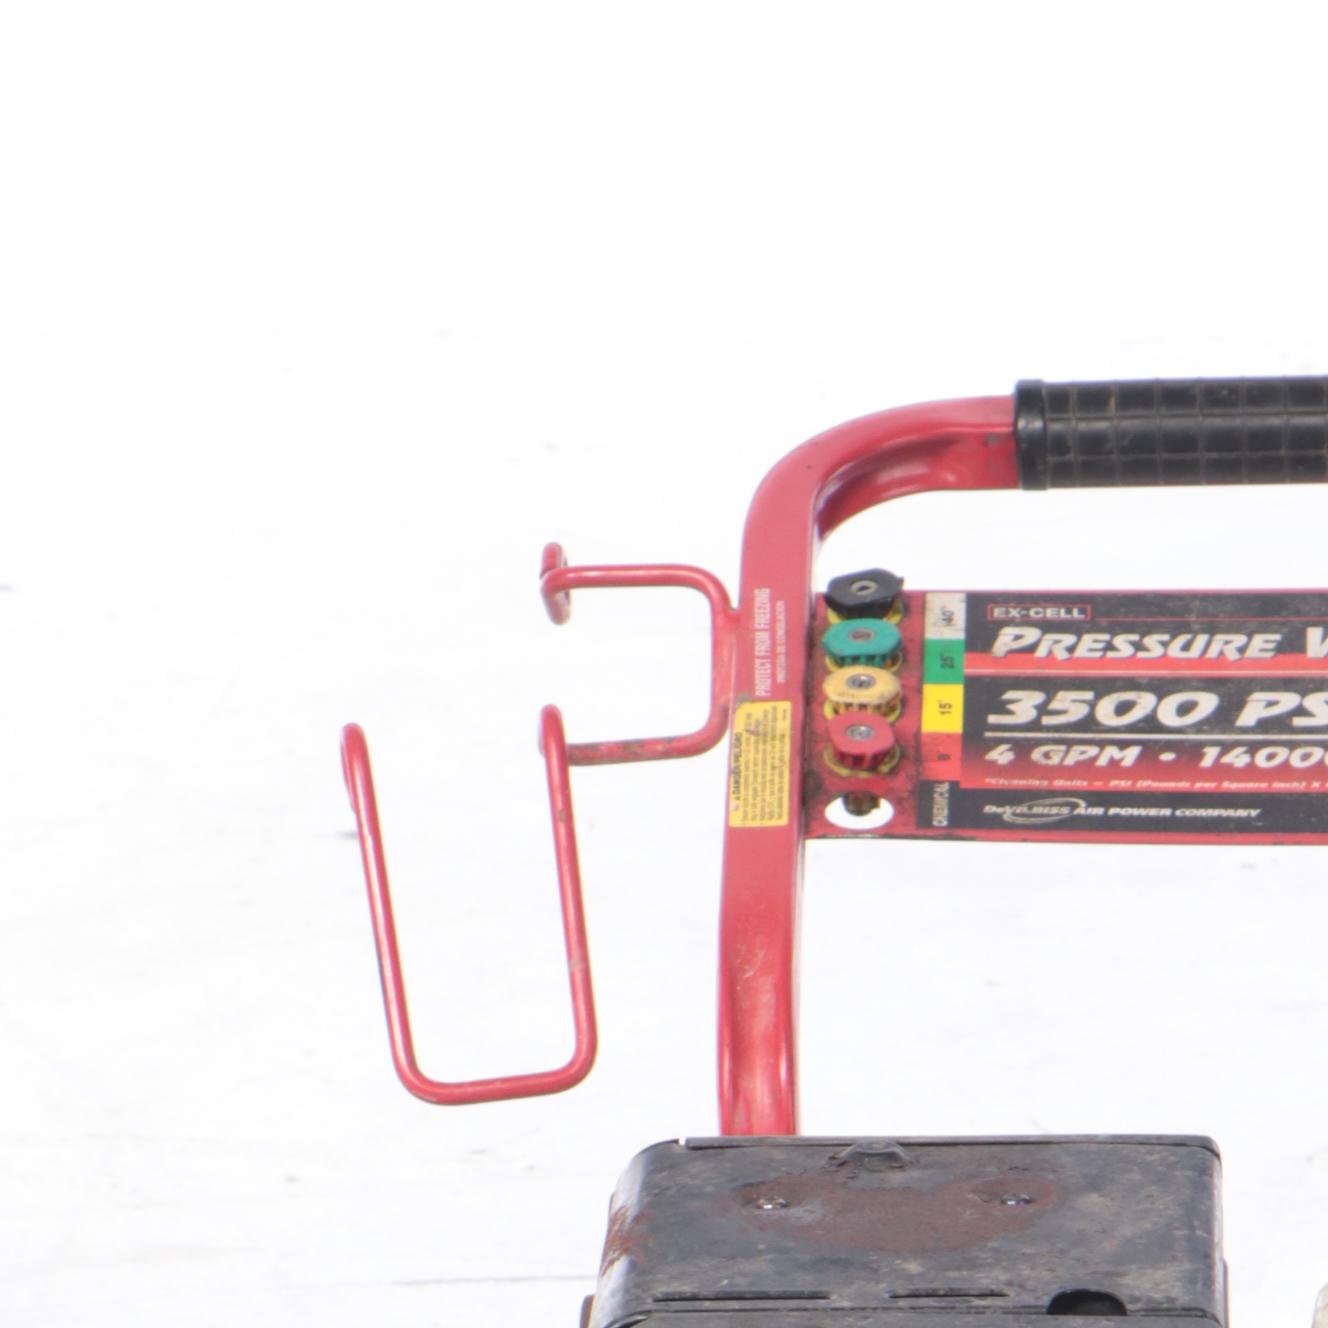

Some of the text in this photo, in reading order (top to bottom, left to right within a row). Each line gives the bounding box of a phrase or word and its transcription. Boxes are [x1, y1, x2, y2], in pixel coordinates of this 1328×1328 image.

[992, 607, 1085, 619] EX-CELL
[755, 588, 771, 696] PROTECT FROM FREEZING
[991, 626, 1283, 661] PRESSURE
[986, 690, 1221, 728] 3500
[984, 744, 1016, 765] 4
[1029, 744, 1143, 767] GPM
[1108, 779, 1133, 788] PSI
[1193, 781, 1218, 790] per
[1220, 780, 1270, 790] Square
[932, 782, 949, 827] CHEMICAL
[1073, 806, 1102, 816] AIR
[1106, 806, 1173, 817] POWER
[1174, 807, 1262, 818] COMPANY
